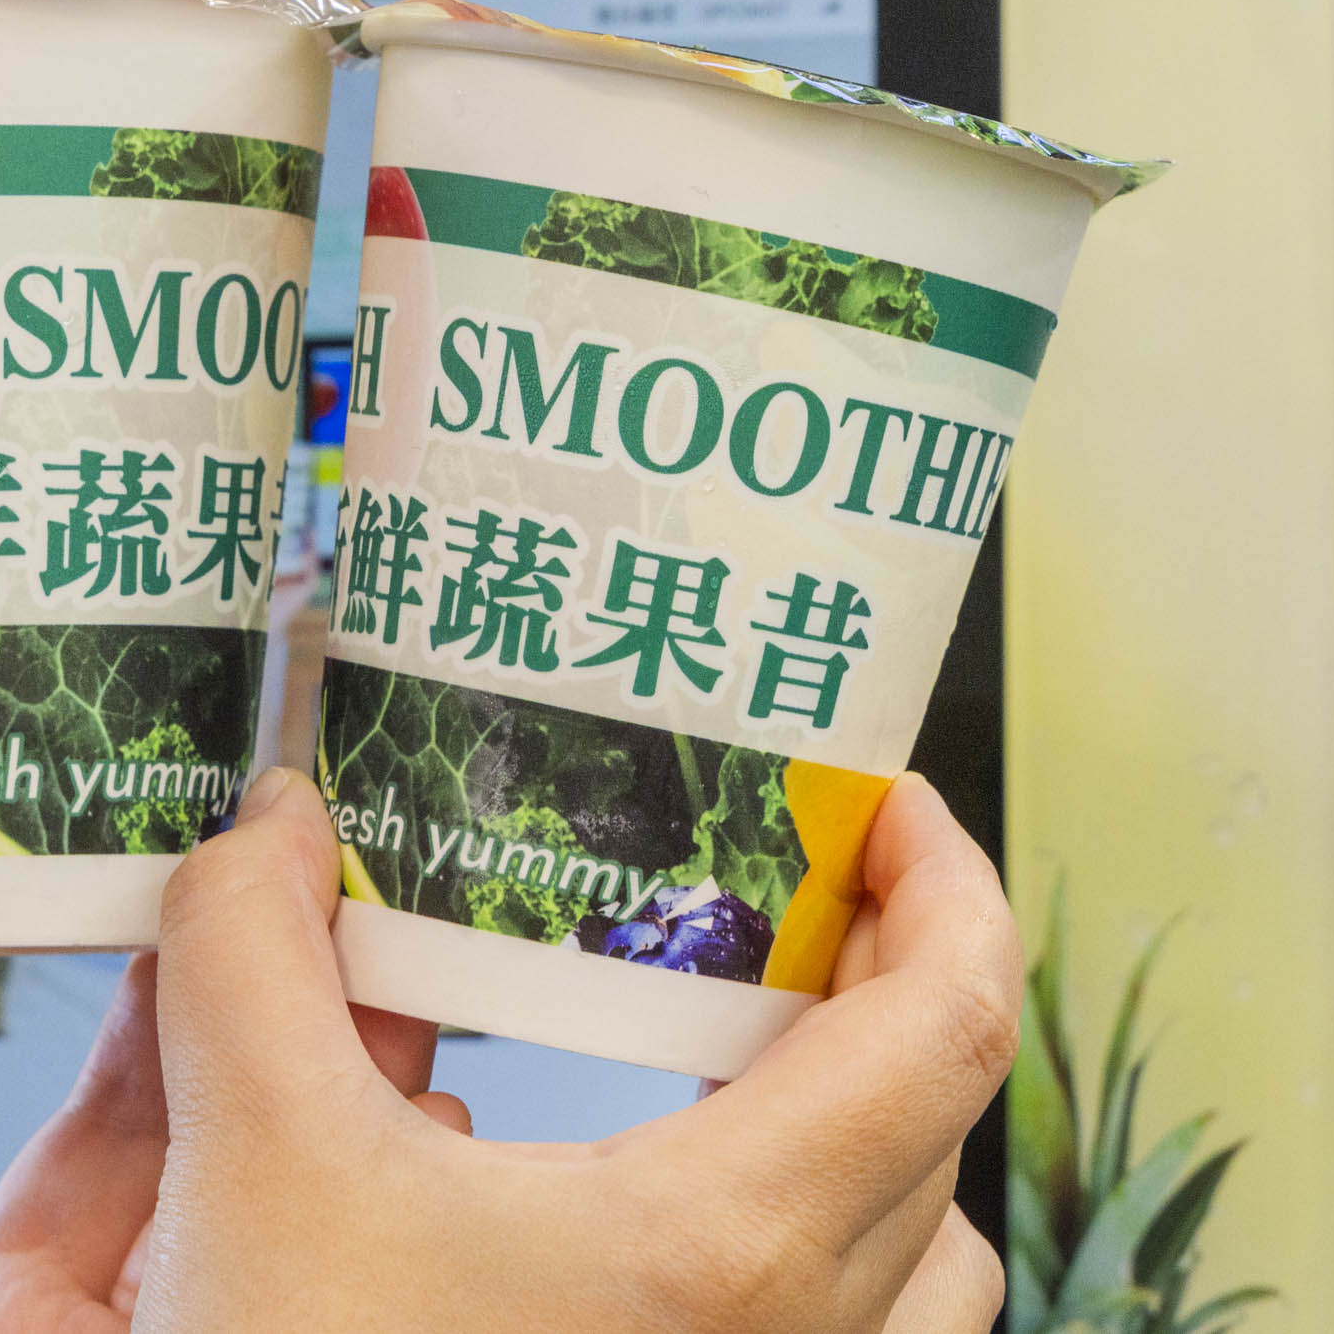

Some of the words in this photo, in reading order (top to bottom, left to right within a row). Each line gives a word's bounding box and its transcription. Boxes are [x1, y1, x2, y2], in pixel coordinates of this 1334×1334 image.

[2, 266, 308, 394] SMOO
[329, 486, 872, 730] 鮮蔬果昔
[71, 762, 238, 816] yummy
[425, 823, 664, 921] yummy
